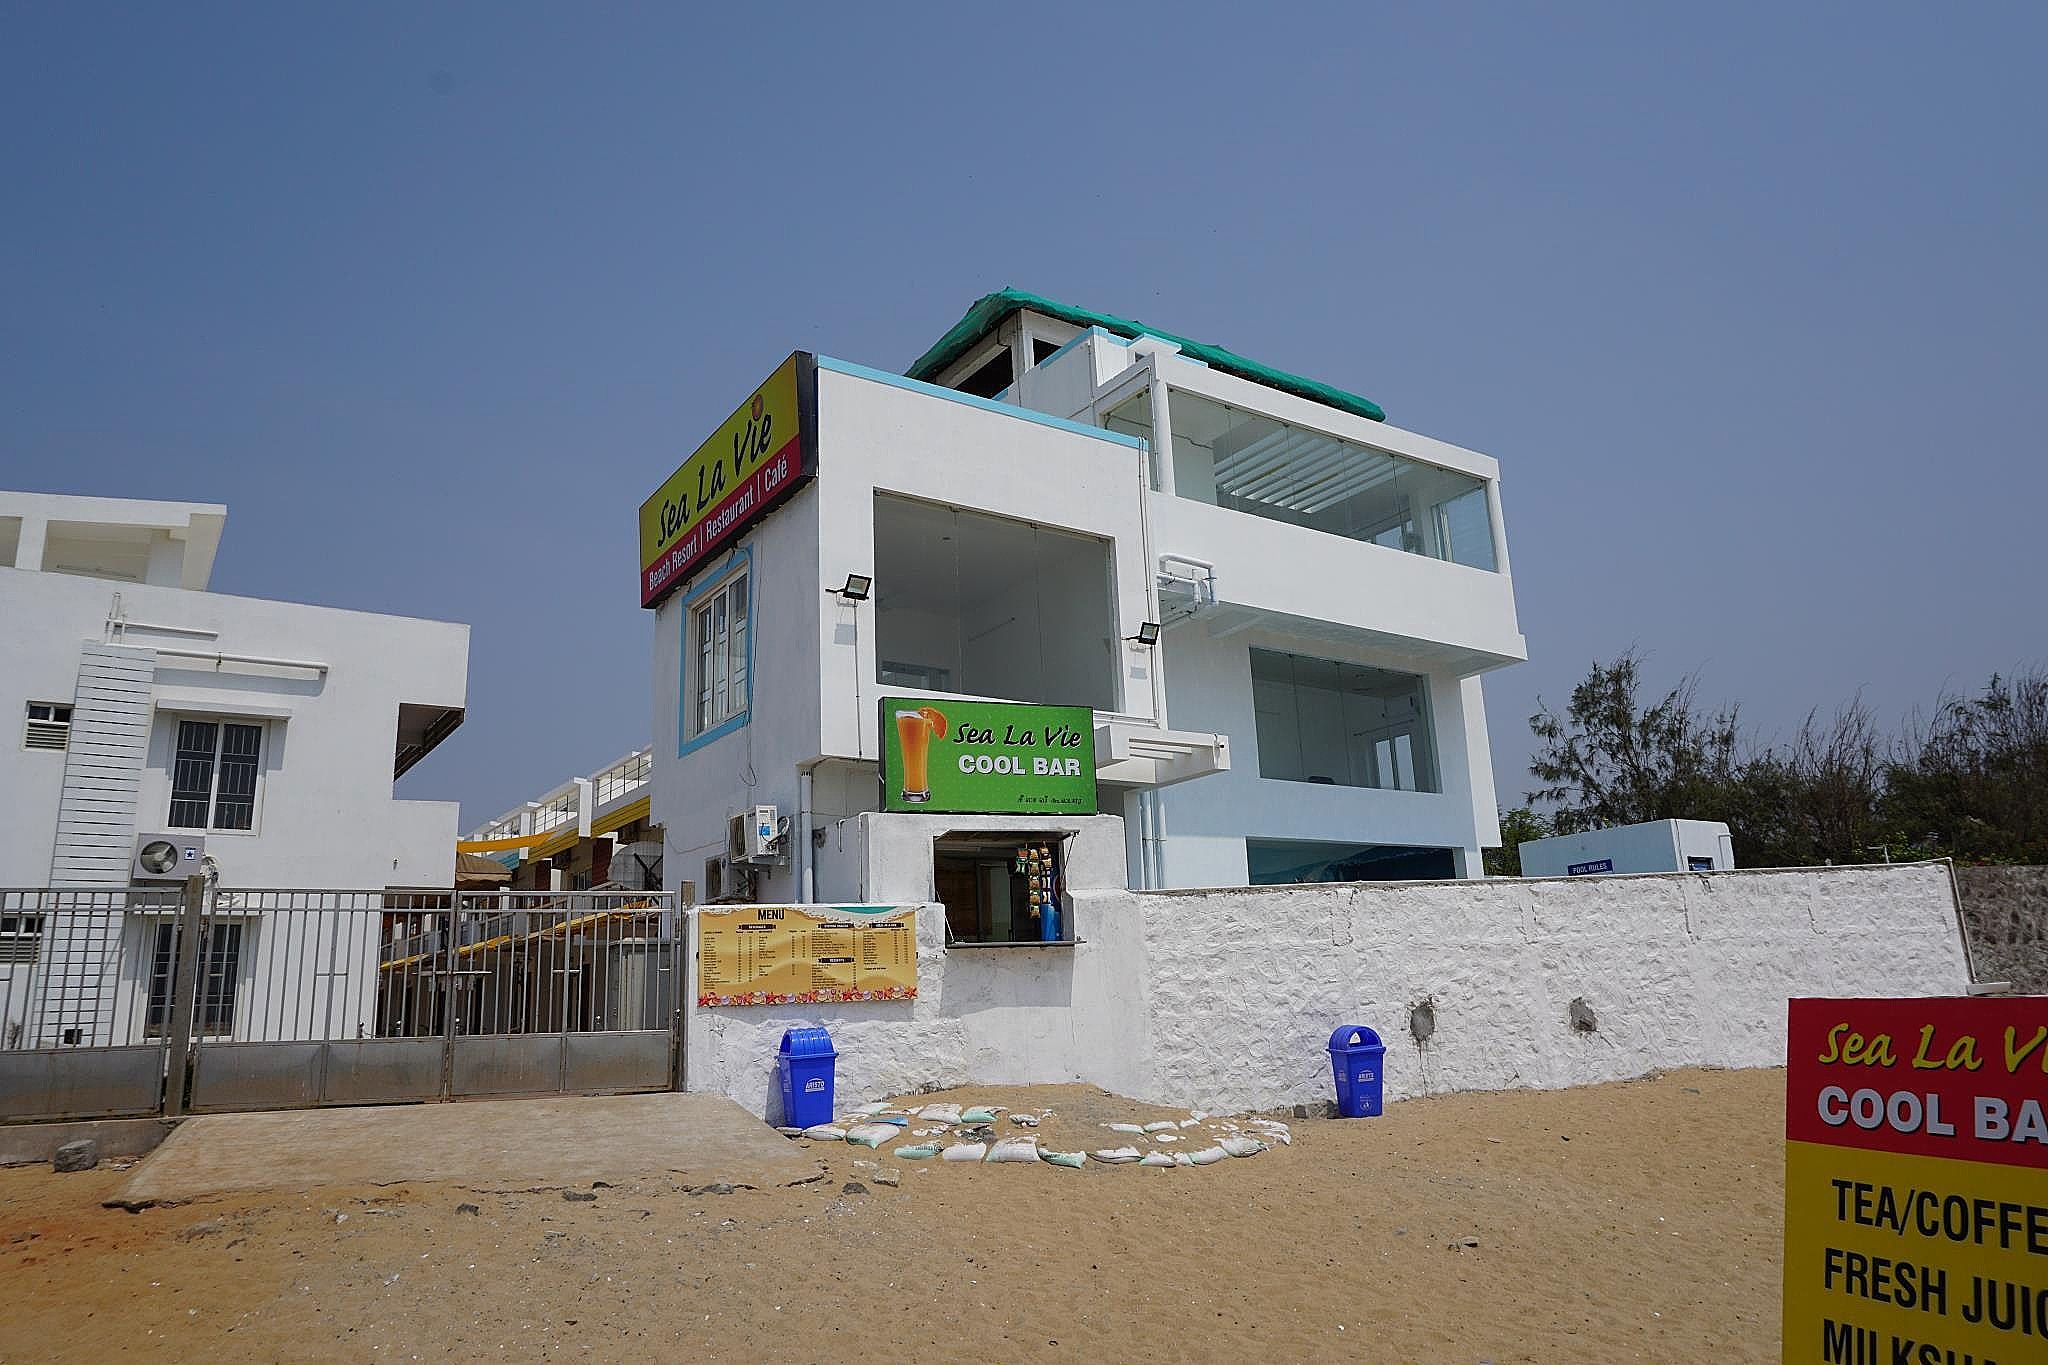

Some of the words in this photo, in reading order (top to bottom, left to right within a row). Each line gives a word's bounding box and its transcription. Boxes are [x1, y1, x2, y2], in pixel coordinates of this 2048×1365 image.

[657, 494, 690, 547] Sea
[697, 459, 726, 511] La
[733, 405, 772, 477] Vie
[649, 558, 670, 591] Beach
[672, 537, 698, 572] Resort
[706, 489, 754, 541] Restaurant
[764, 454, 788, 491] Café
[953, 722, 996, 745] Sea
[1003, 724, 1036, 747] La
[1045, 725, 1081, 748] Vie
[958, 754, 1026, 775] COOL
[1033, 756, 1081, 776] BAR
[757, 909, 785, 920] MENU
[1817, 1022, 1898, 1067] Sea
[1911, 1023, 1984, 1072] La
[1817, 1085, 1956, 1137] COOL
[1974, 1095, 2048, 1145] BA
[1831, 1178, 2048, 1256] TEA/COFFE
[1824, 1247, 1948, 1316] FRESH
